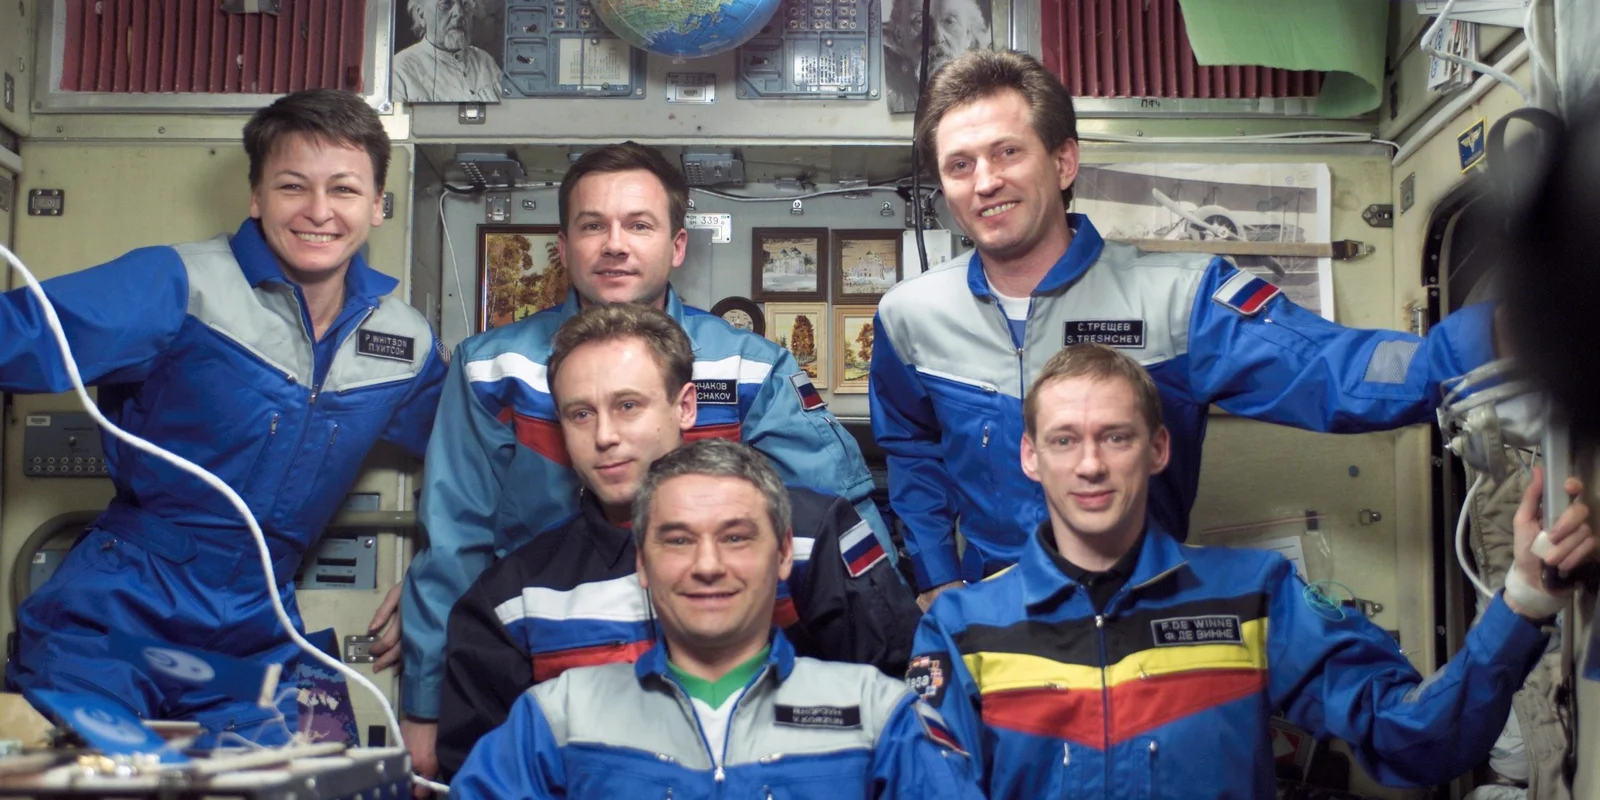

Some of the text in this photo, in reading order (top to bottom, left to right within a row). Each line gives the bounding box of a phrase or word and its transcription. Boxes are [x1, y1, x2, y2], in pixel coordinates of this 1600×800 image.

[700, 216, 719, 224] 339
[1077, 322, 1131, 332] С.ТРЕЩЕВ
[365, 333, 408, 349] P.WHITSON
[1066, 334, 1140, 344] S.TRESHCHEV
[697, 392, 731, 400] CHAKOV
[1194, 618, 1234, 628] WINNE
